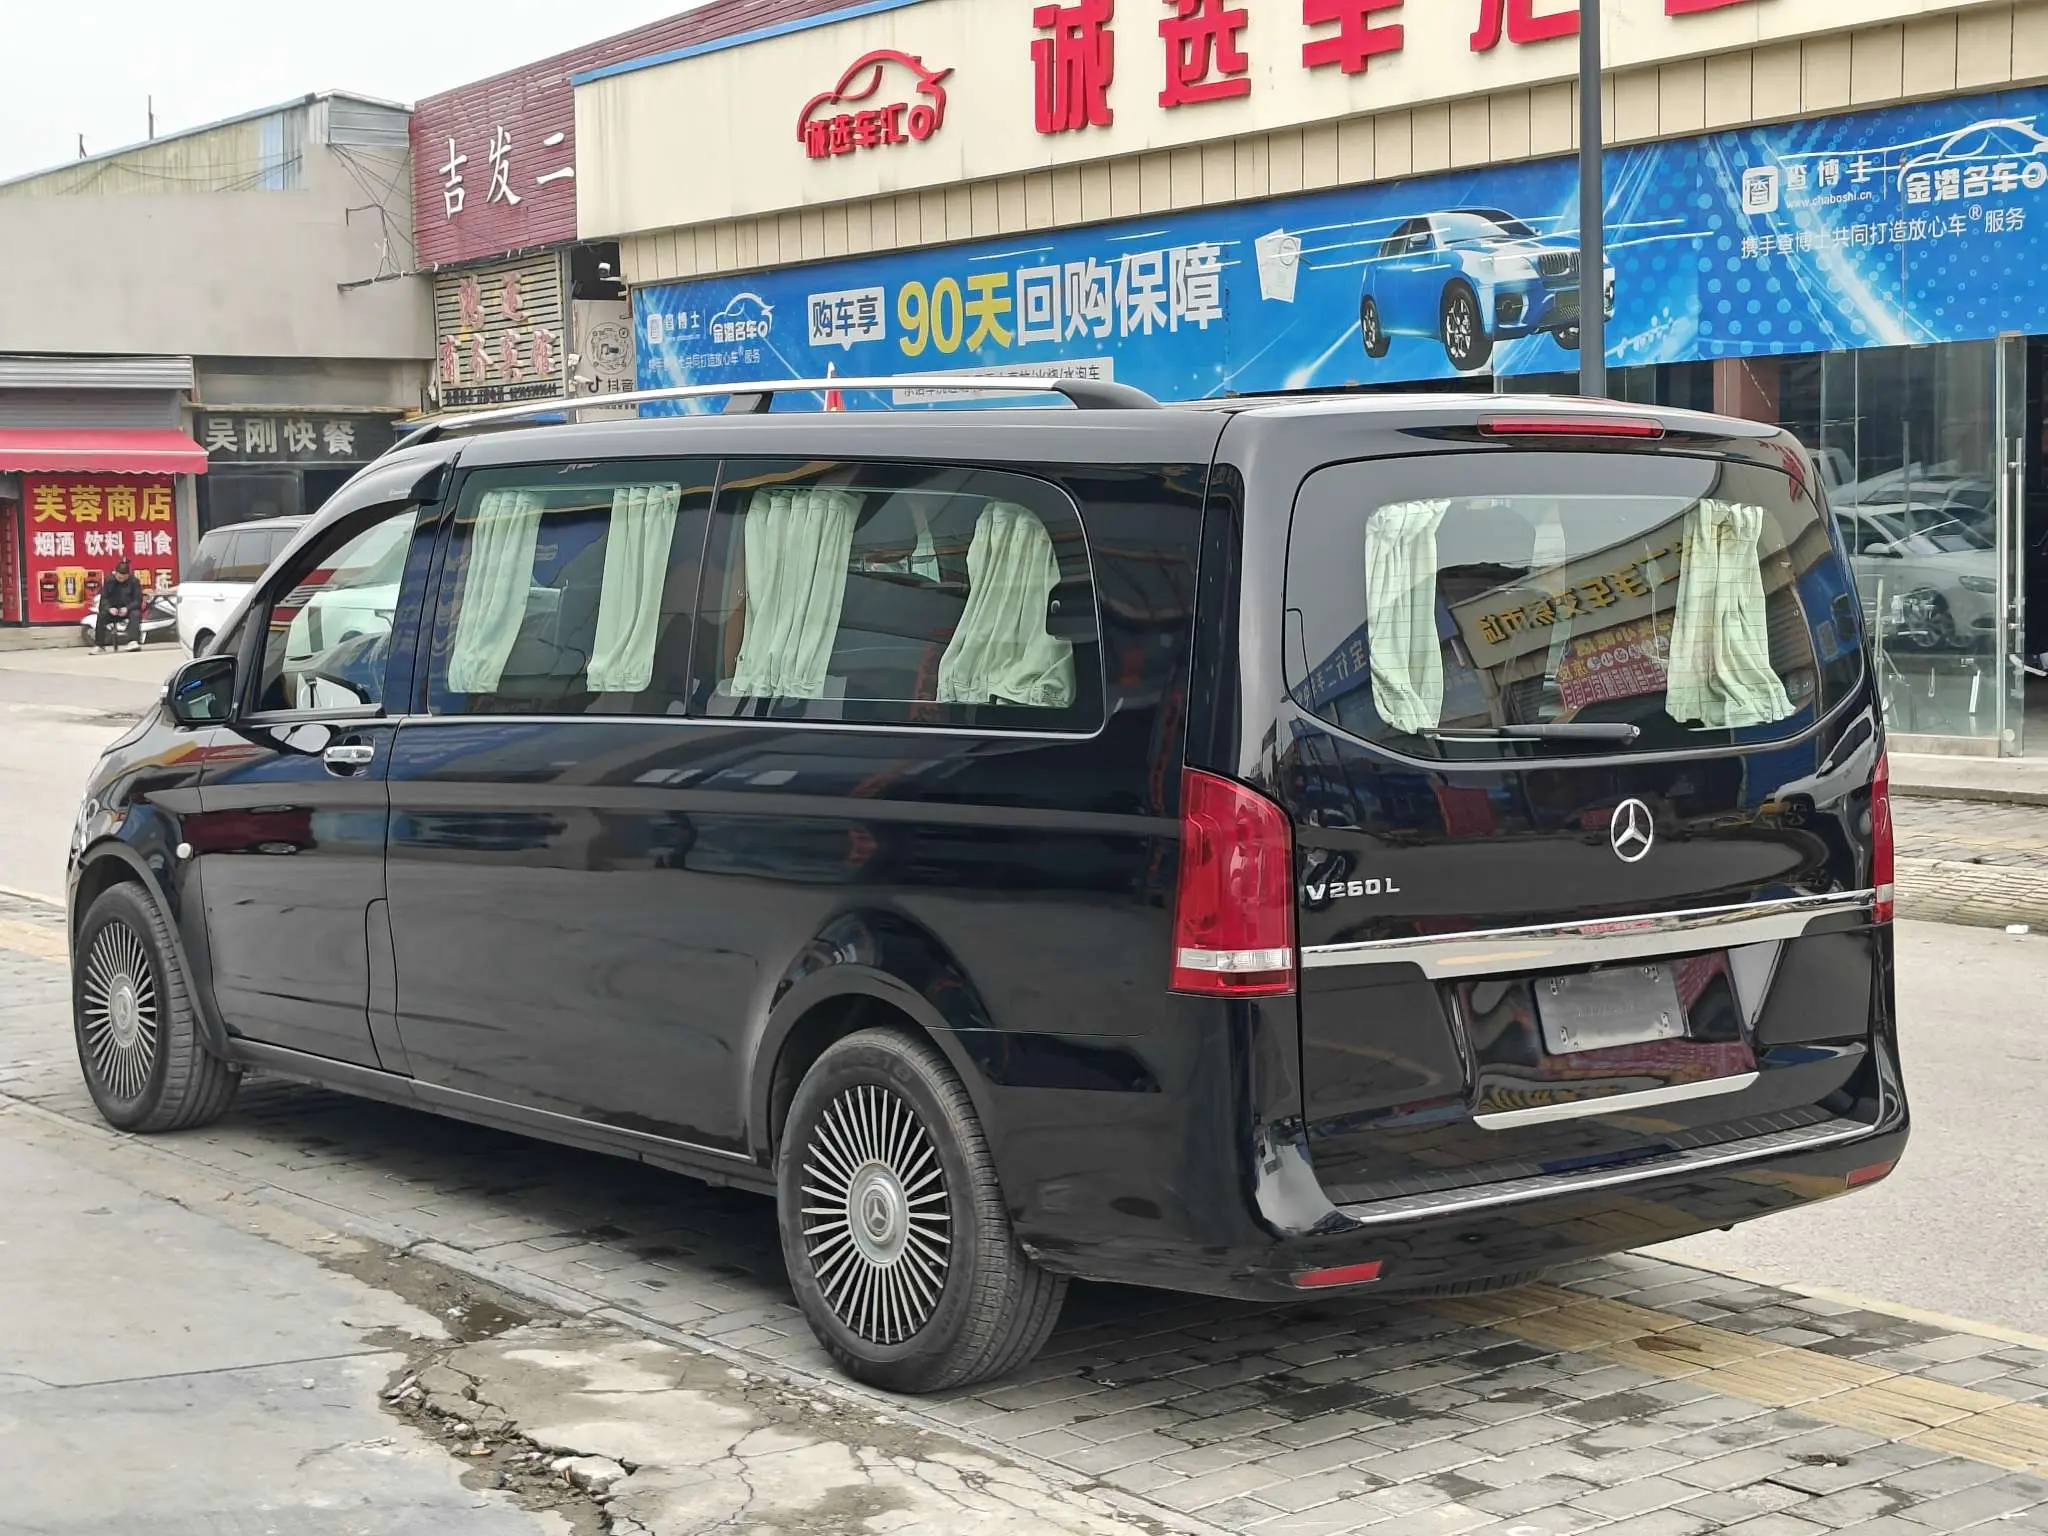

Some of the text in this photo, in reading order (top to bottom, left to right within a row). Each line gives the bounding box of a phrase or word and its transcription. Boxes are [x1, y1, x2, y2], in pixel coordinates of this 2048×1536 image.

[805, 102, 909, 158] 诚选车汇
[438, 125, 575, 220] 吉发二
[1785, 155, 1873, 191] 查博士
[812, 294, 879, 338] 购车享
[898, 246, 1222, 357] 90天回购保障
[608, 379, 634, 392] 抖音
[206, 418, 355, 454] 吴刚快餐
[33, 484, 172, 523] 芙蓉商店
[34, 530, 173, 557] 烟酒 饮料 副食
